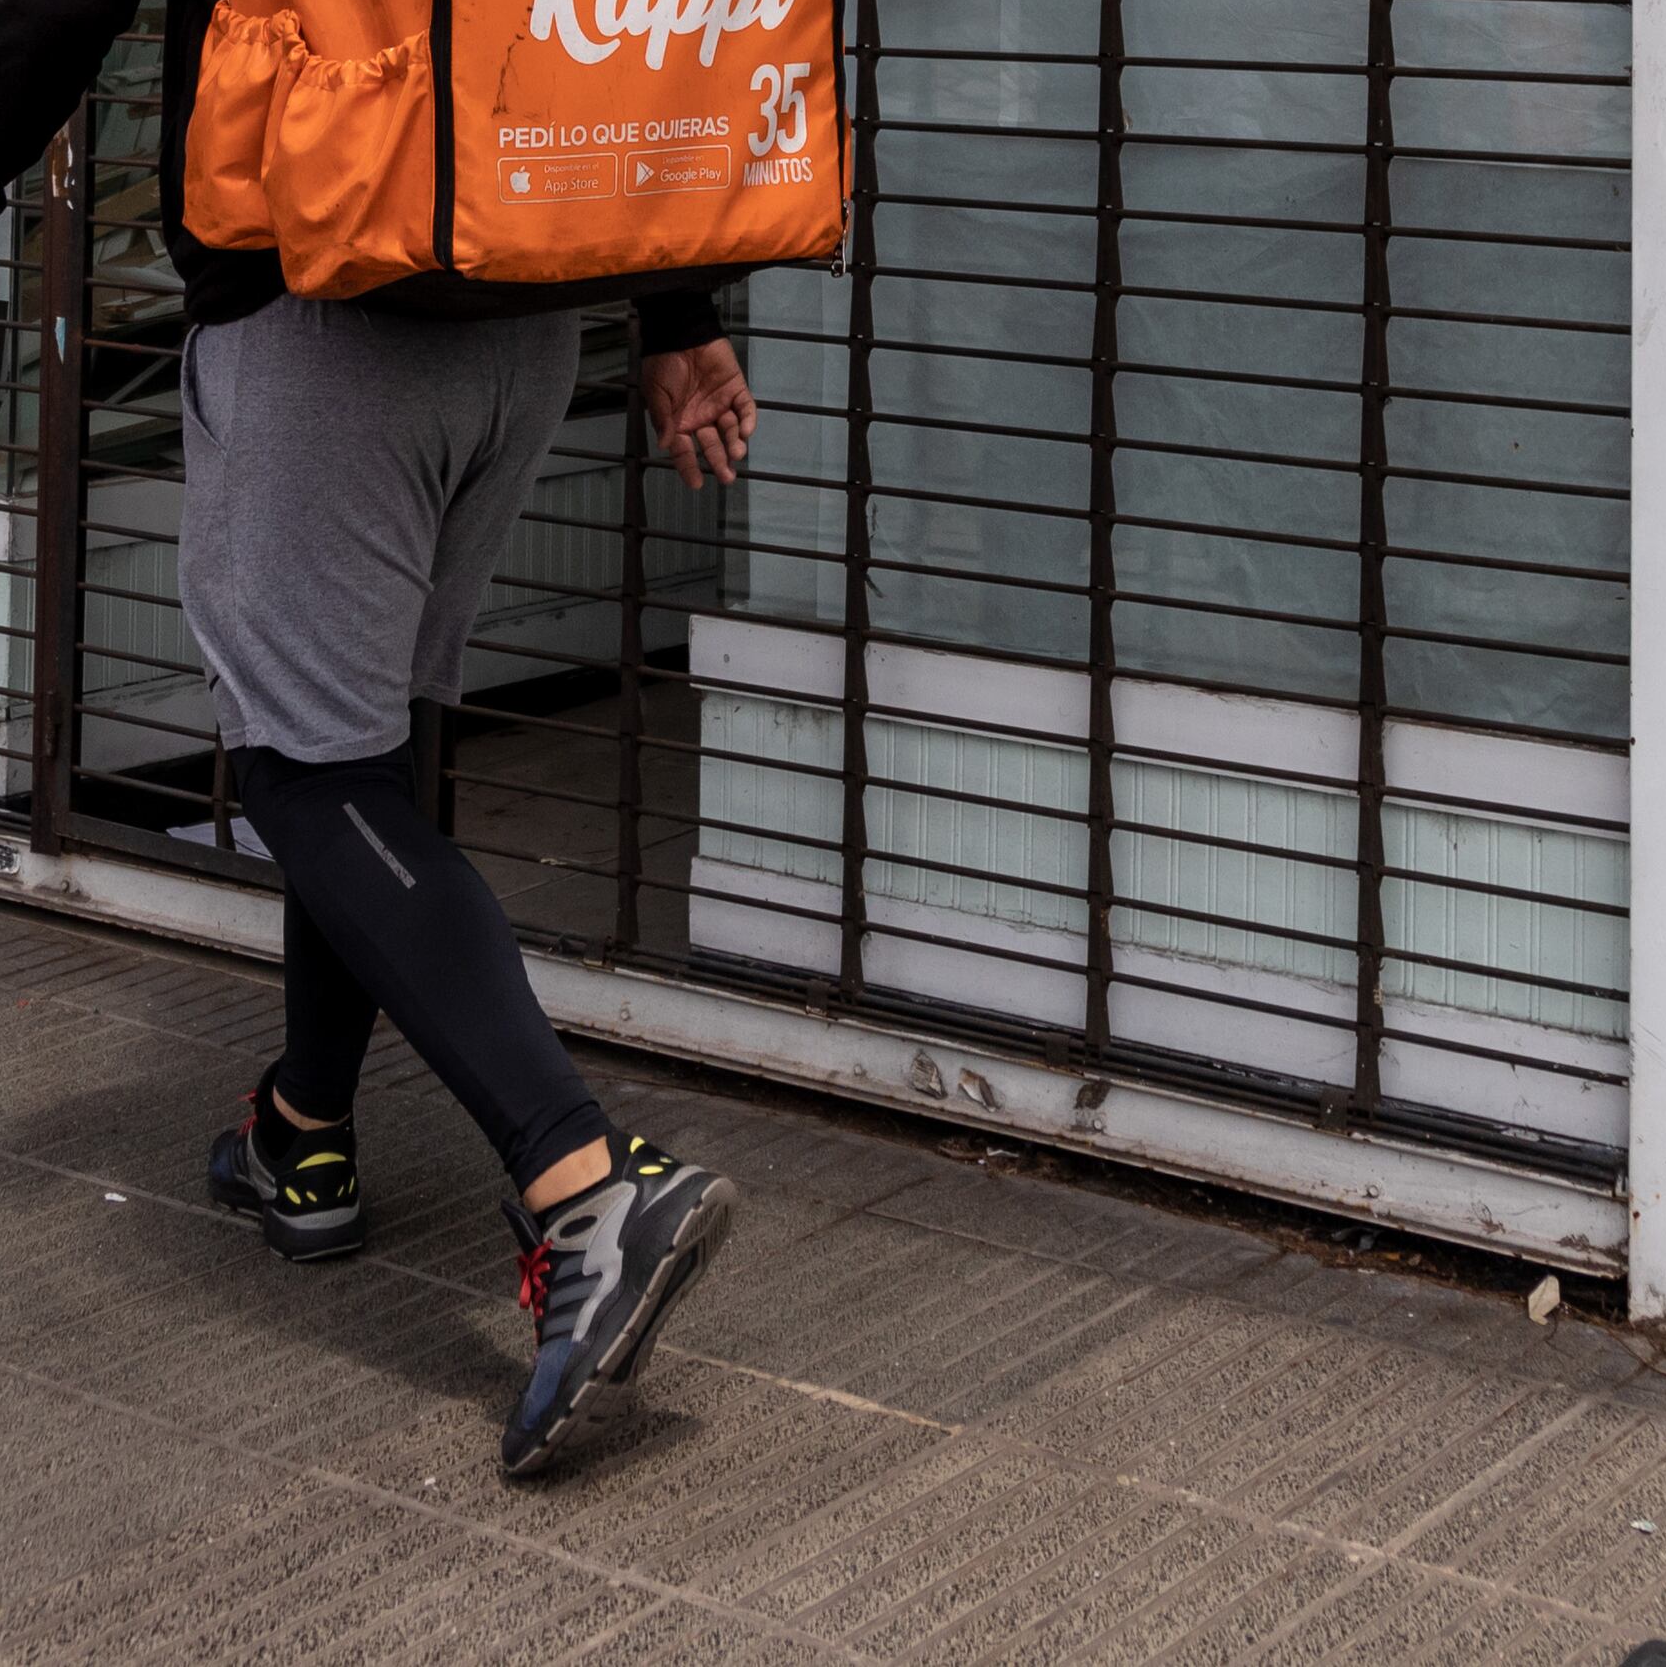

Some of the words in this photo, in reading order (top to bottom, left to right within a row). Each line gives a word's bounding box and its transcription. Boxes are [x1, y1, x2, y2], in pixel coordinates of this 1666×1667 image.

[748, 62, 812, 157] 35
[499, 121, 555, 149] PEDÍ
[560, 126, 587, 147] LO
[592, 123, 640, 145] QUE
[644, 116, 730, 142] QUIERAS
[544, 179, 568, 193] App
[570, 177, 599, 190] Store
[660, 169, 697, 185] Google
[699, 166, 722, 181] Play
[743, 157, 813, 189] MINUTOS
